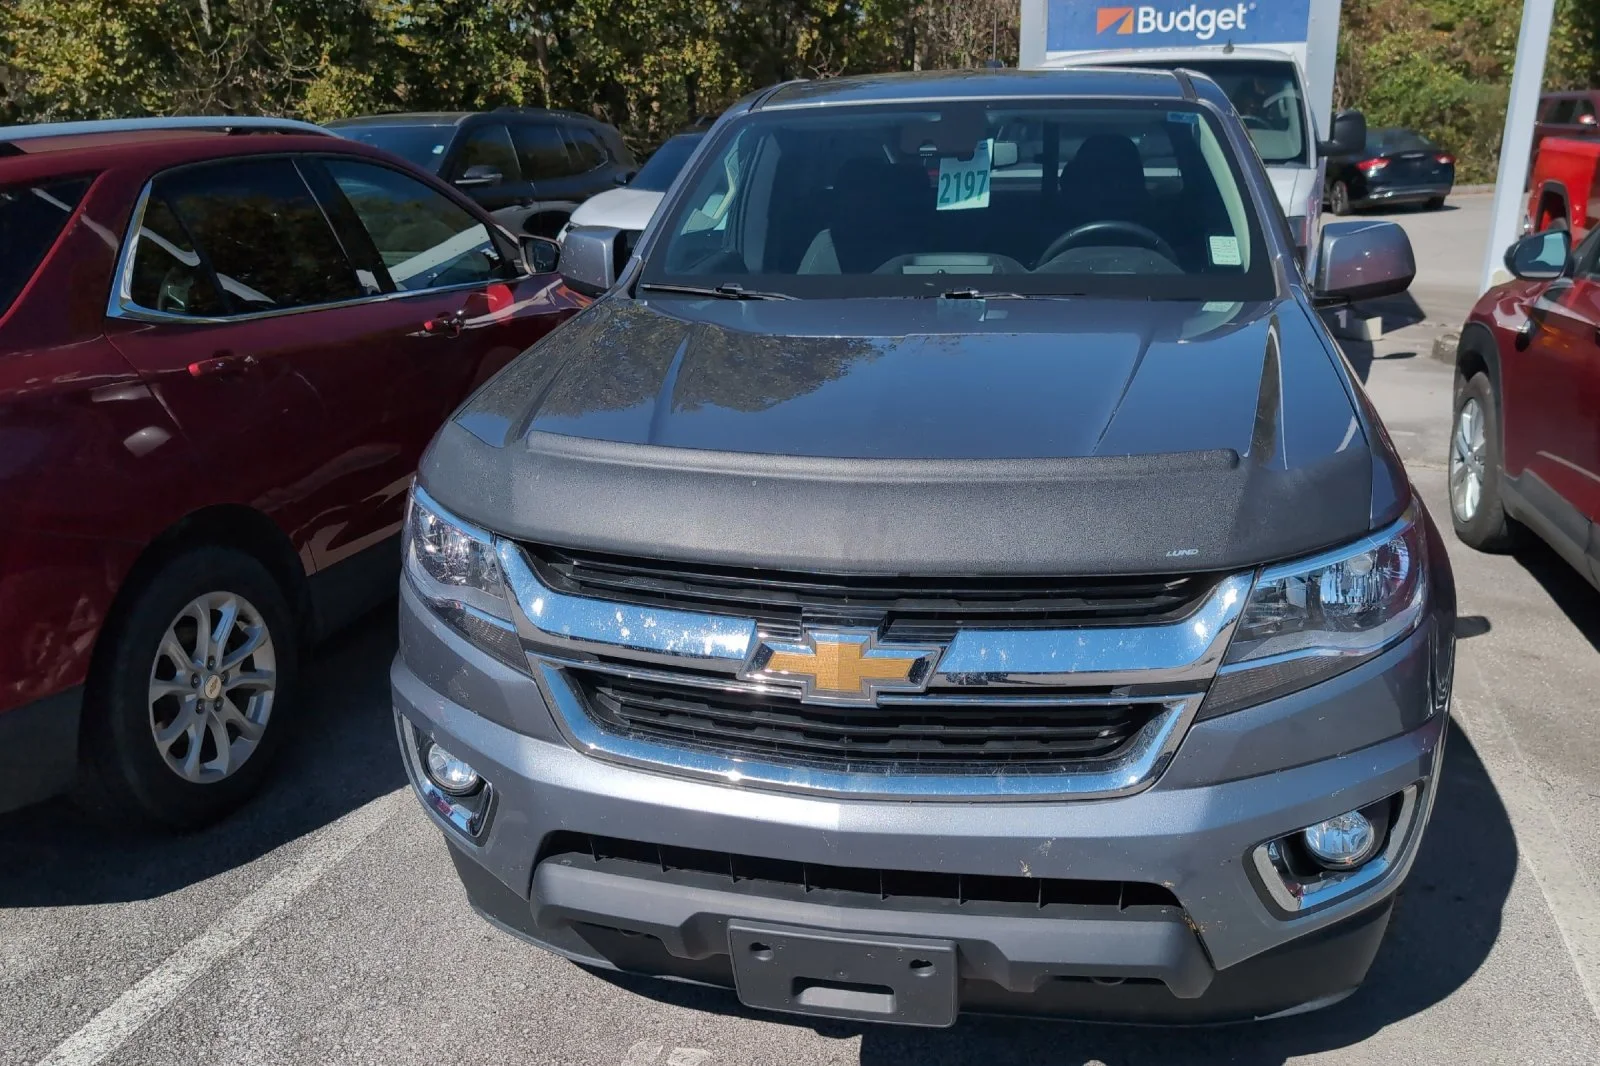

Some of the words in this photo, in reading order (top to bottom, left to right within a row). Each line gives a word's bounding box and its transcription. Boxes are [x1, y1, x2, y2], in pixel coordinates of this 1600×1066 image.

[1137, 3, 1247, 40] Budget
[939, 169, 988, 204] 2197
[1166, 548, 1199, 557] LUND
